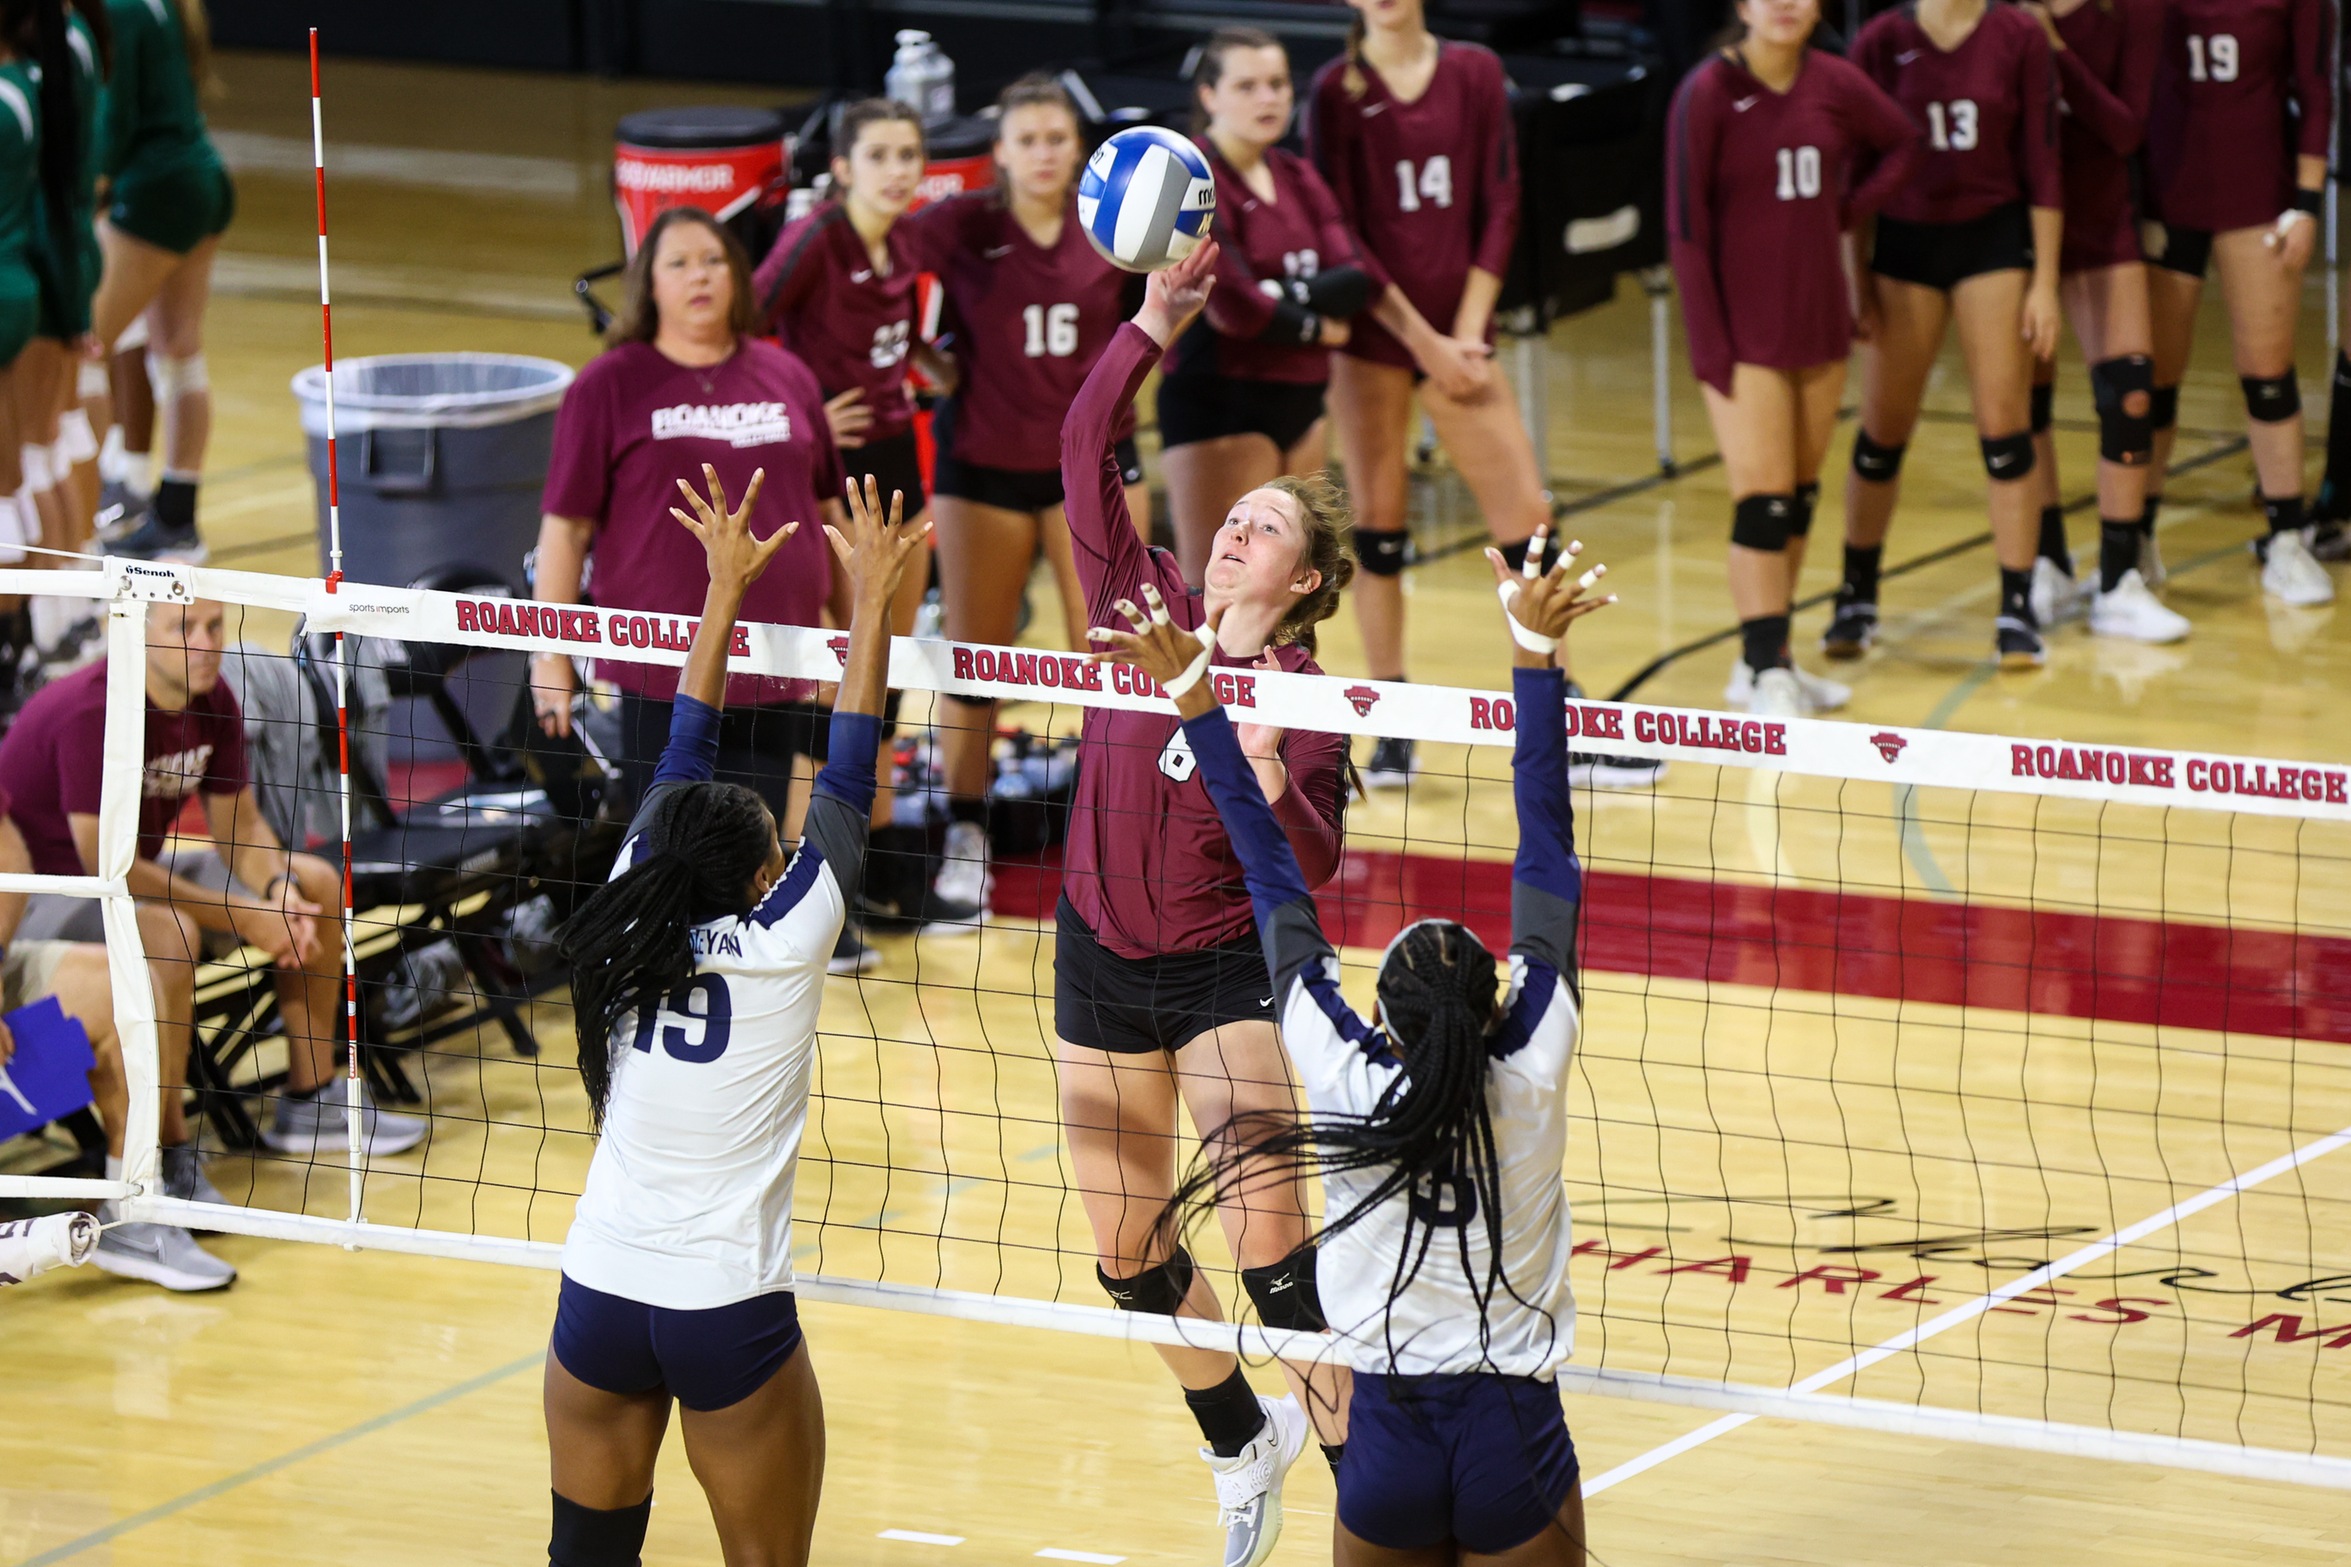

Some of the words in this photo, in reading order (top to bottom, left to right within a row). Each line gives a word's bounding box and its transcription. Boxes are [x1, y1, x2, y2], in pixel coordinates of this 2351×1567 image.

[2186, 34, 2240, 82] 19
[1926, 99, 1979, 150] 13
[1395, 154, 1453, 212] 14
[1776, 146, 1821, 201] 10
[1023, 303, 1080, 358] 16
[651, 401, 790, 433] ROANOKE
[134, 566, 175, 578] Senoh
[349, 604, 375, 613] sports
[456, 600, 602, 643] ROANOKE
[608, 614, 750, 658] COLLE
[953, 646, 1103, 692] ROANOKE
[1470, 697, 1625, 740] ROOKE
[1634, 711, 1787, 756] COLLEGE
[2011, 744, 2176, 788] ROANOKE
[2187, 759, 2349, 804] COLLEGE
[632, 972, 733, 1064] 19
[1570, 1239, 2176, 1325] HARLES
